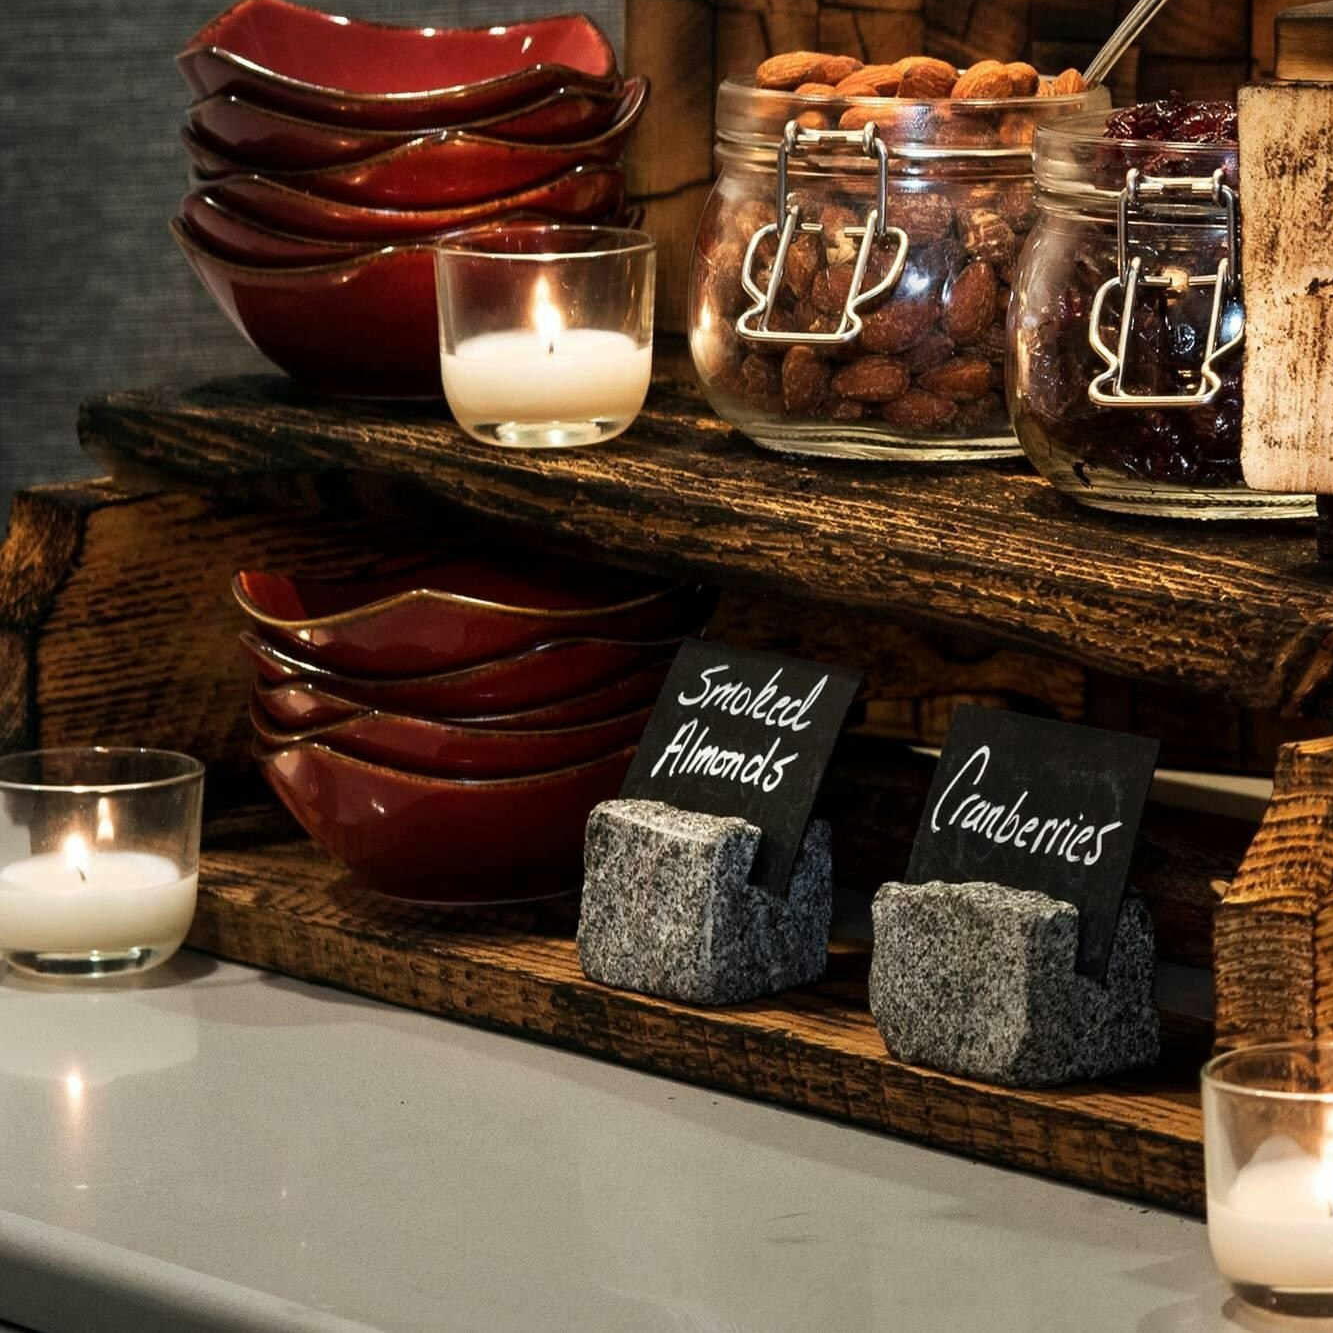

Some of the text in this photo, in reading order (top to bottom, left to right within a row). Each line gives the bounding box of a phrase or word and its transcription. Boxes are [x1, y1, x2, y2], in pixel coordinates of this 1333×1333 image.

[677, 664, 829, 732] Smoked
[650, 718, 799, 793] Almonds
[930, 745, 1123, 866] Cranberries
